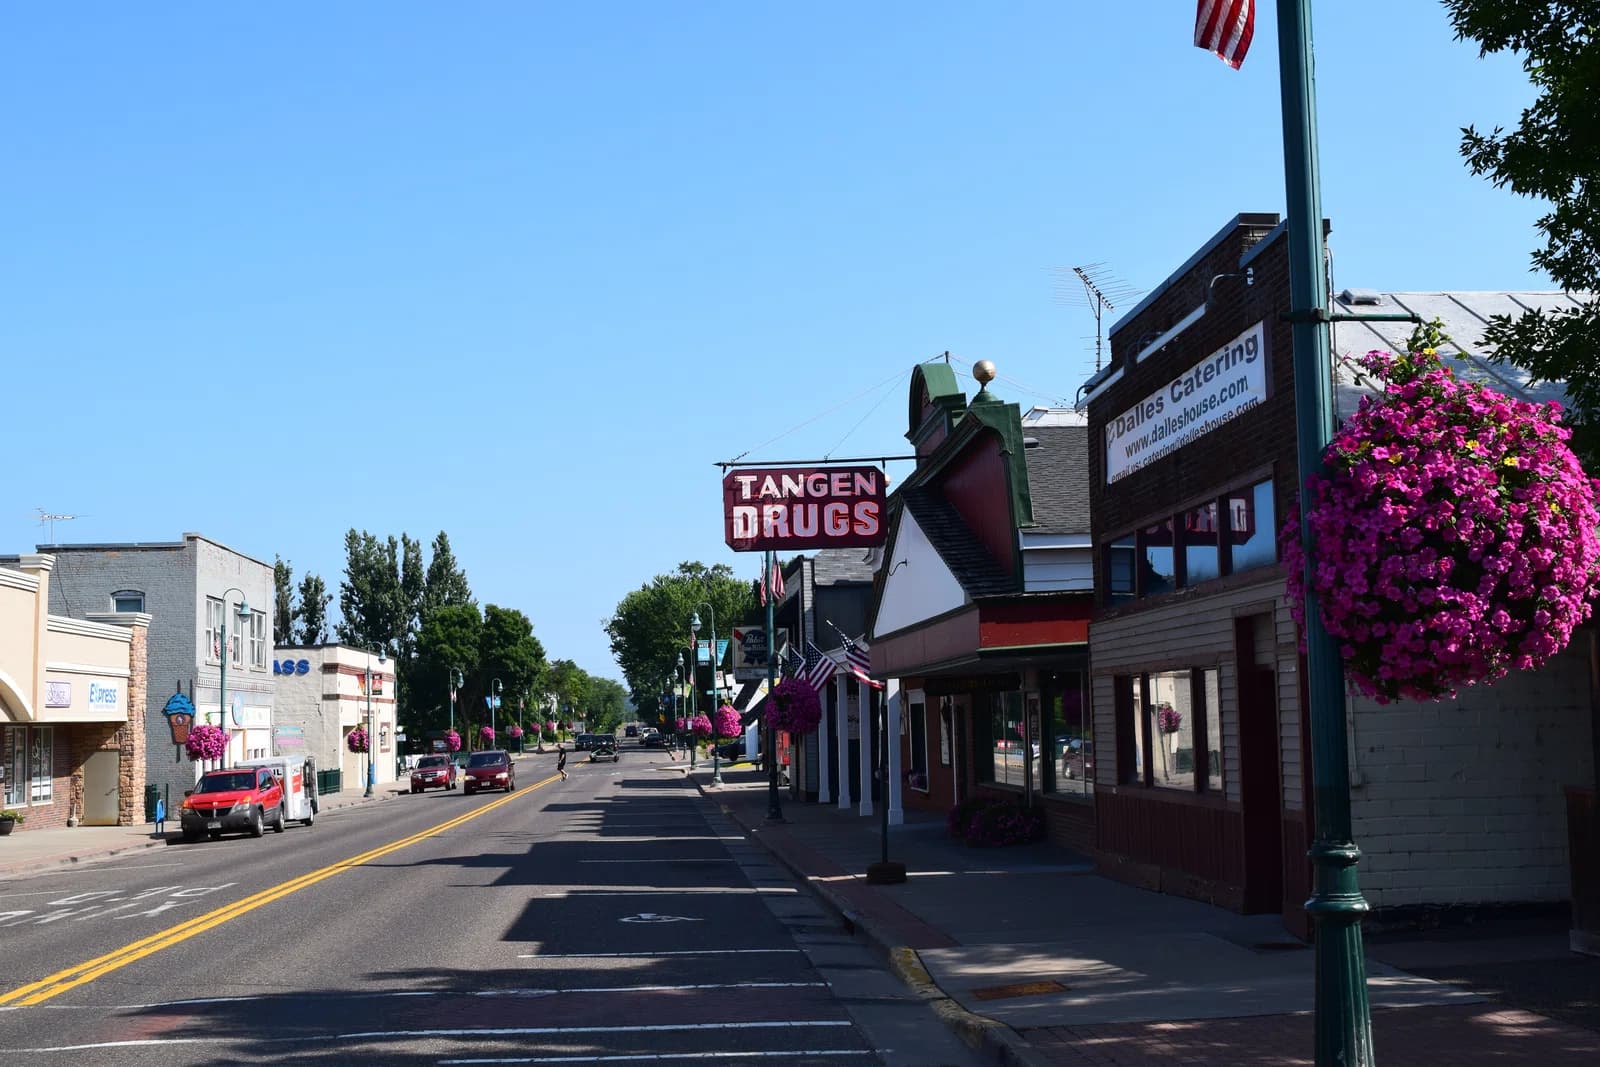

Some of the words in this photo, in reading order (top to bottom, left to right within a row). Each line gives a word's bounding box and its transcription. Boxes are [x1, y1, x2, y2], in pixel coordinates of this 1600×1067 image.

[1117, 395, 1164, 441] Dalles
[1170, 334, 1258, 403] Catering
[1124, 374, 1249, 459] www.dalleshouse.com
[734, 471, 877, 500] TANGEN
[732, 501, 880, 540] DRUGS
